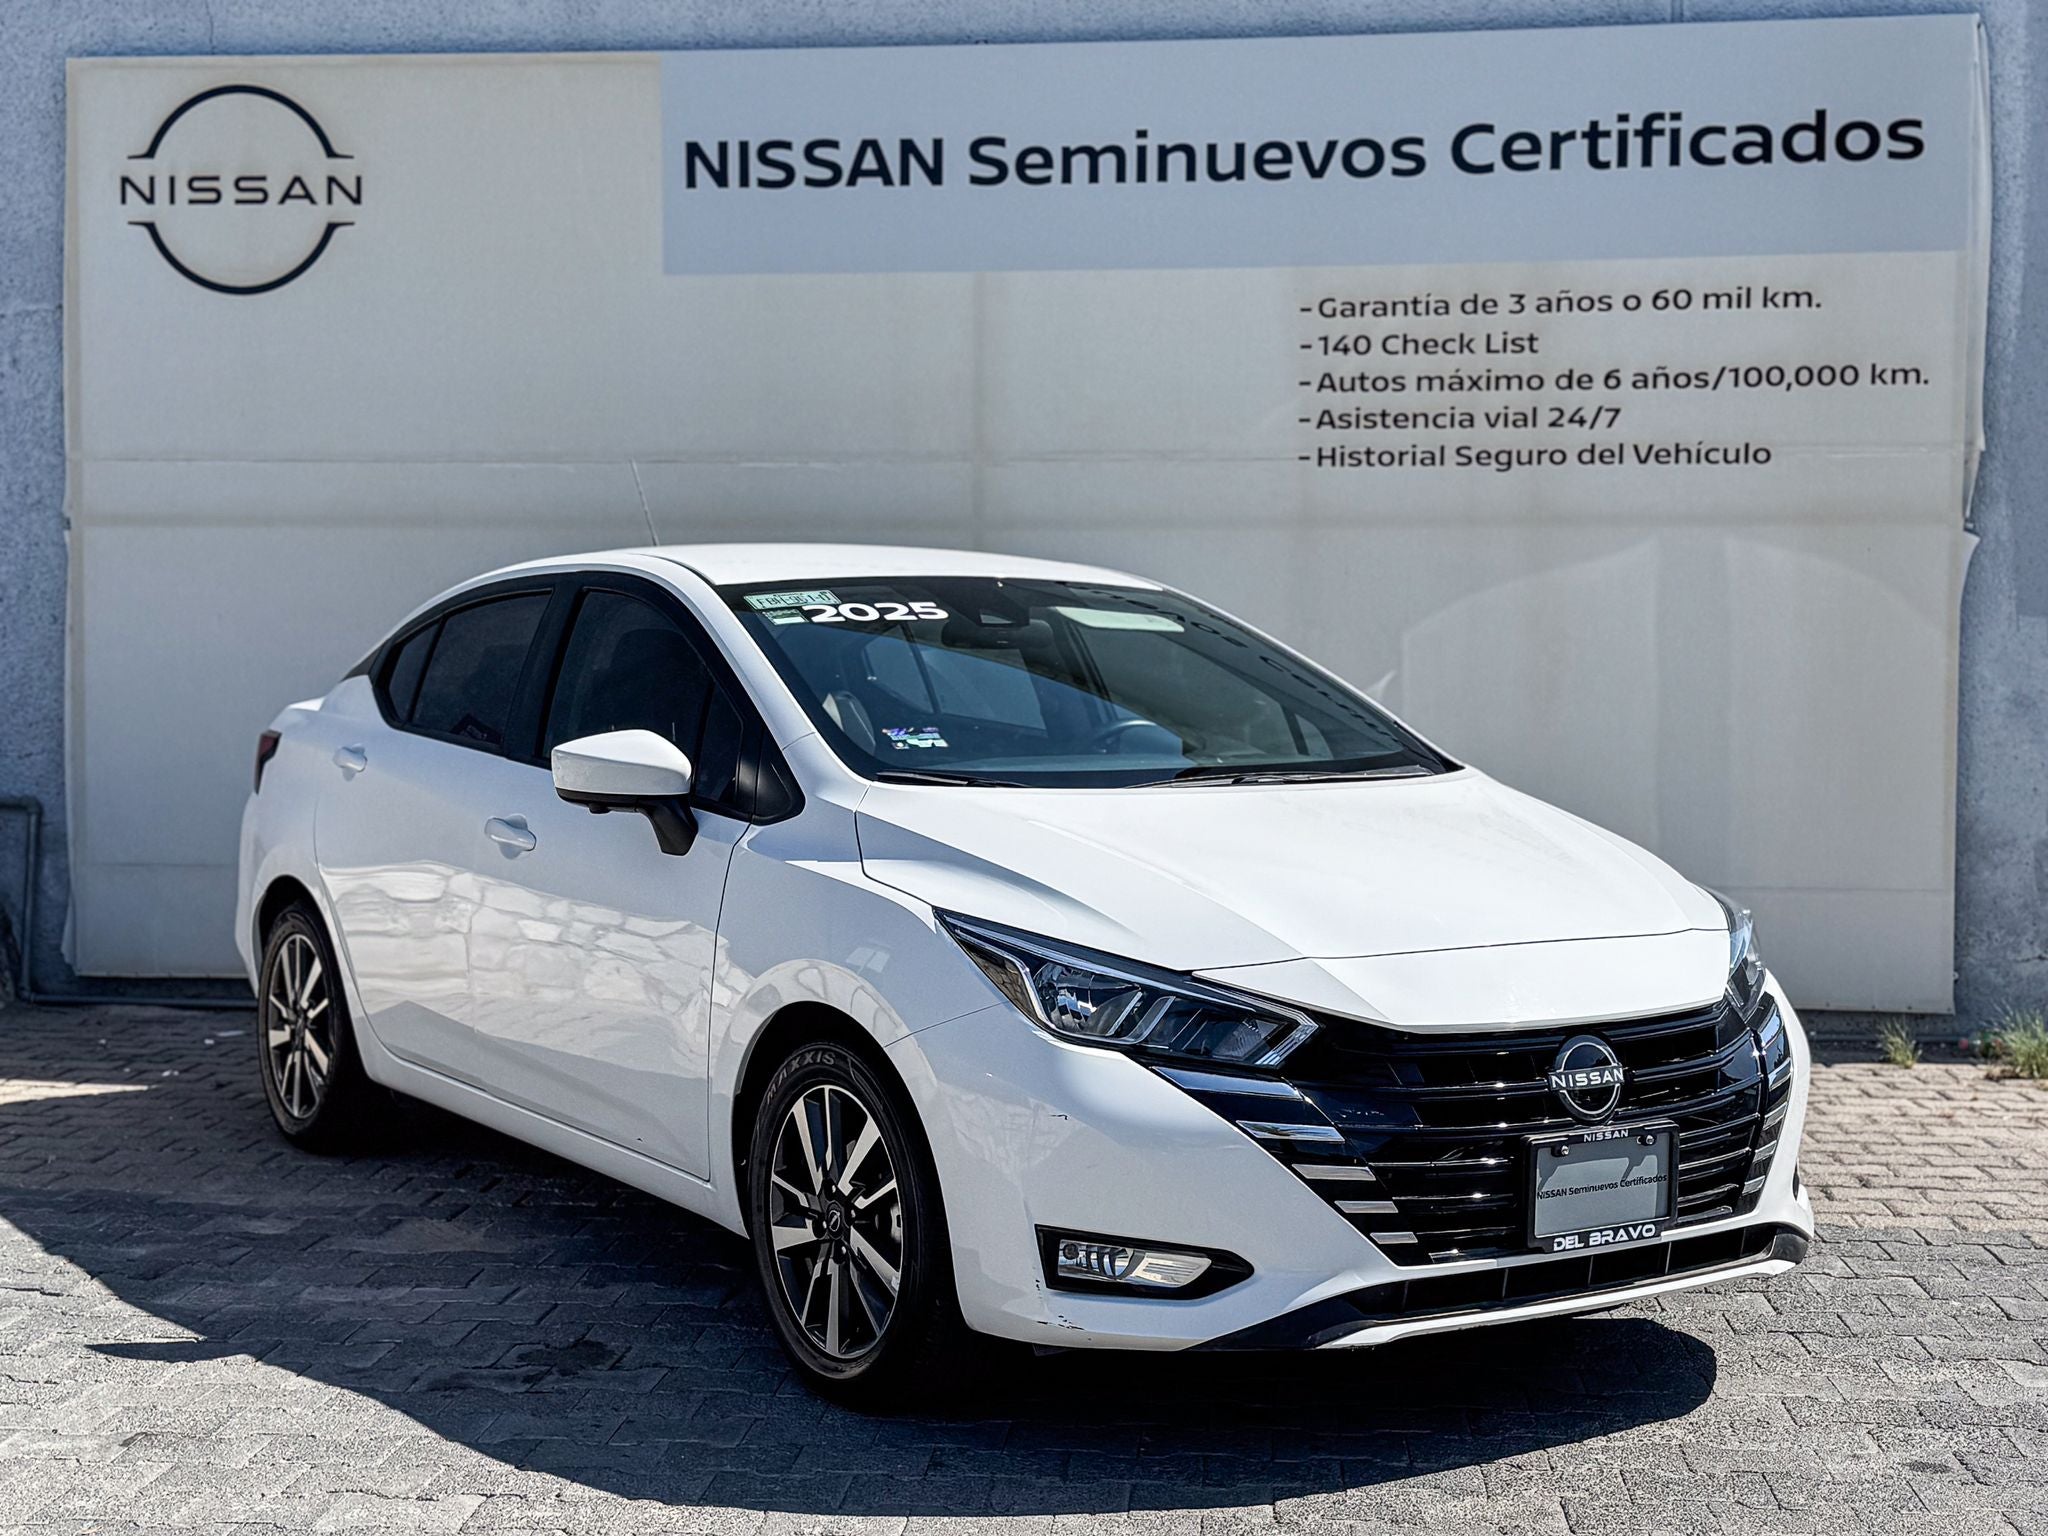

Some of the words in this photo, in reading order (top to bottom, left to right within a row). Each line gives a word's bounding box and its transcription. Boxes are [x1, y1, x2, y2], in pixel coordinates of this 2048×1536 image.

[685, 138, 943, 189] NISSAN
[969, 129, 1426, 186] Seminuevos
[1451, 108, 1925, 175] Certificados
[120, 175, 362, 205] NISSAN
[1460, 293, 1499, 315] de
[1508, 293, 1526, 315] 3
[1535, 290, 1613, 314] años
[1622, 294, 1642, 312] o
[1652, 289, 1693, 311] 60
[1703, 286, 1752, 310] mil
[1762, 286, 1821, 309] km.
[1381, 332, 1475, 355] Check
[1485, 331, 1539, 354] List
[1416, 368, 1545, 392] máximo
[1555, 368, 1594, 391] de
[1603, 368, 1622, 390] 6
[1631, 364, 1860, 392] años/100,000
[1870, 363, 1929, 385] km.
[1484, 405, 1538, 429] vial
[1548, 405, 1621, 430] 24/7
[1455, 445, 1567, 473] Seguro
[1577, 442, 1624, 465] del
[1633, 441, 1772, 465] Vehículo
[802, 602, 949, 622] 2025
[767, 1050, 836, 1105] MAXXIS
[1551, 1068, 1624, 1088] NISSAN
[1584, 1129, 1629, 1142] NISSAN
[1537, 1187, 1568, 1200] NISSAN
[1569, 1183, 1619, 1196] Seminuevos
[1619, 1174, 1668, 1188] Certificados
[1553, 1234, 1584, 1251] DEL
[1589, 1224, 1656, 1246] BRAVO
